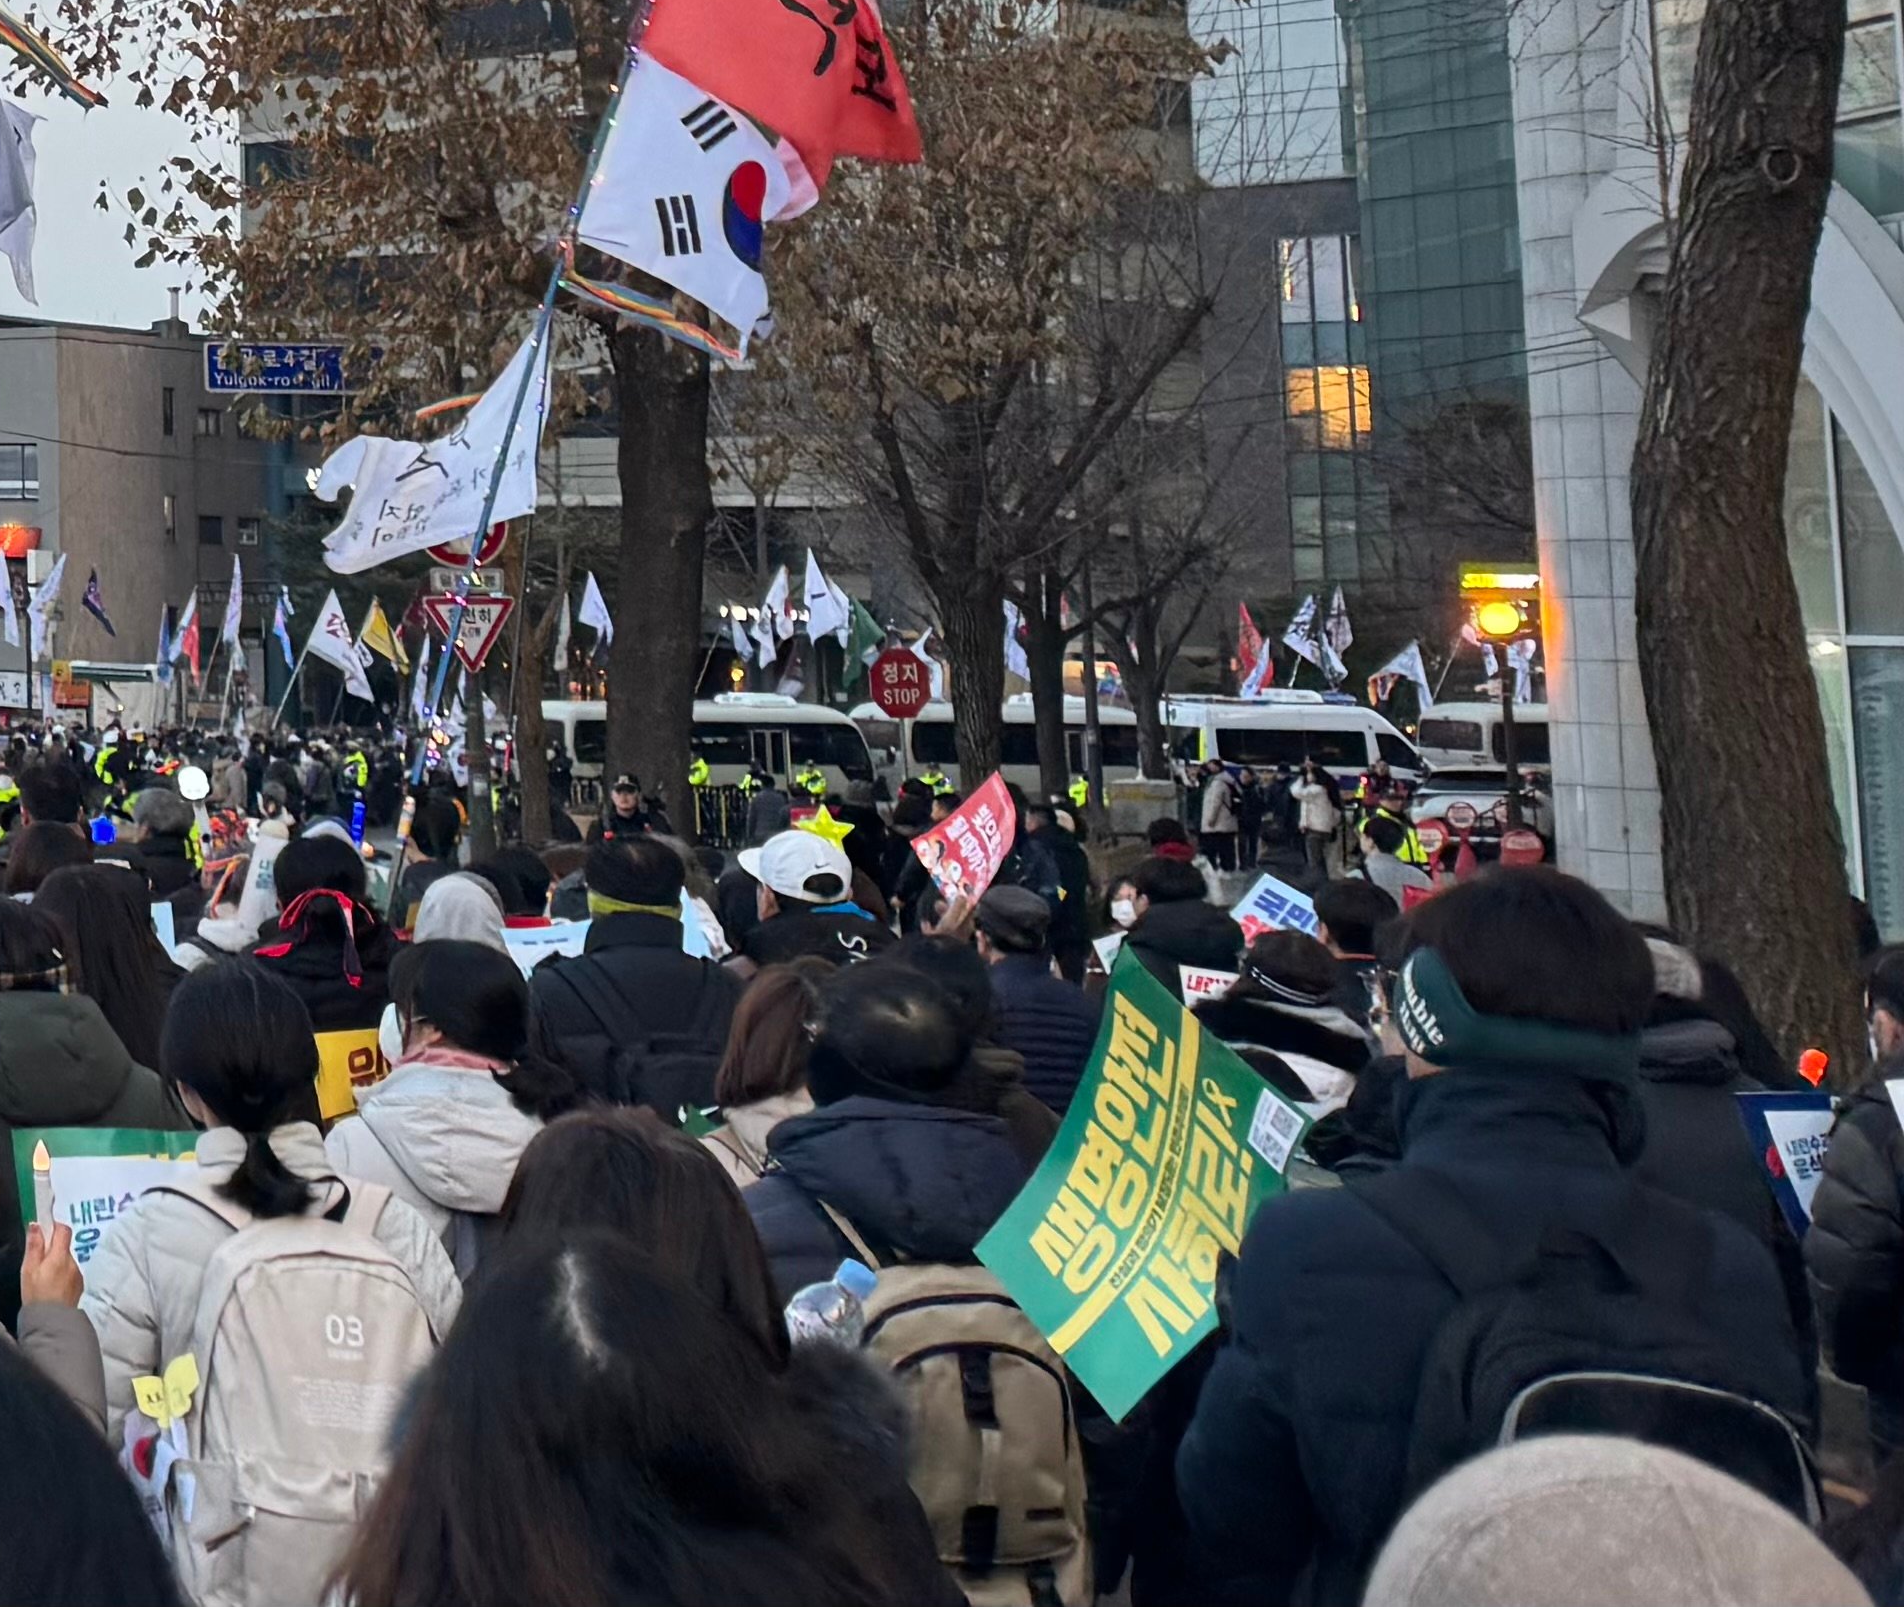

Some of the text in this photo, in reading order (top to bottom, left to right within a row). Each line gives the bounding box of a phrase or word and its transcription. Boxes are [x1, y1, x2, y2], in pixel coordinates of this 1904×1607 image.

[213, 347, 317, 372] 로4길
[448, 607, 491, 624] 천히
[882, 661, 919, 684] 정지
[883, 688, 921, 706] STOP
[1252, 886, 1320, 936] 국민
[1032, 990, 1175, 1295] 생명안전
[1123, 1099, 1254, 1358] 사회로!
[325, 1313, 365, 1347] 03
